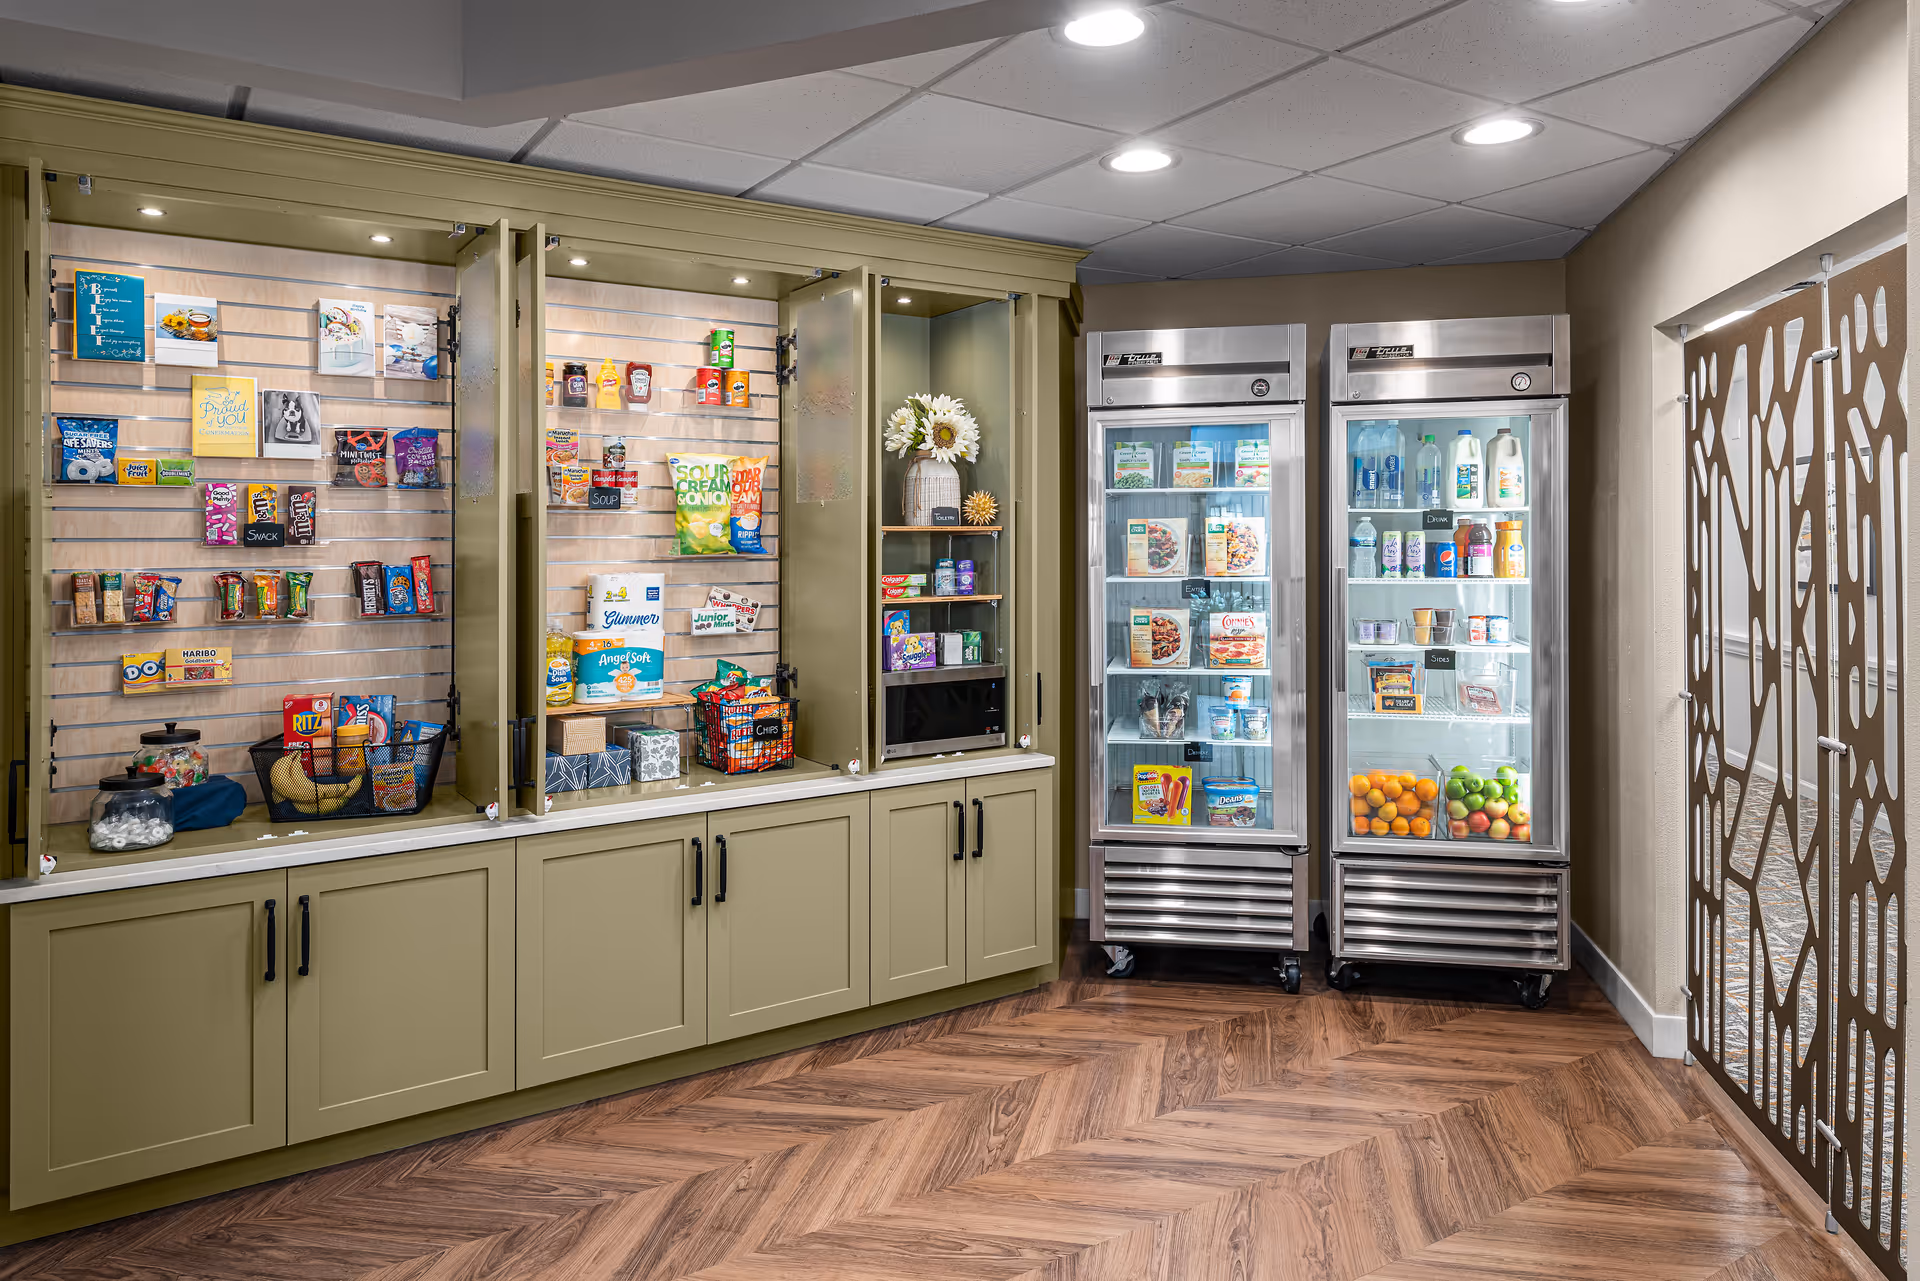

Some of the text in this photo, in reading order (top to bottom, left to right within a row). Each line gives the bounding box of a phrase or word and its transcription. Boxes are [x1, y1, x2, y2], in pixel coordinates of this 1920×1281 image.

[222, 396, 234, 406] So
[200, 400, 249, 419] Proud
[206, 418, 214, 428] of
[80, 438, 113, 448] SAVERS
[126, 463, 149, 471] Juicy
[676, 463, 730, 481] SOUR
[127, 470, 149, 478] Fruit
[676, 479, 730, 493] CREAM
[592, 492, 619, 505] SOUP
[1427, 514, 1448, 523] DRINK
[247, 529, 279, 541] SNACK
[362, 578, 377, 614] HERSHEY'S
[606, 586, 627, 599] 2 4
[602, 611, 660, 629] Glimmer
[694, 612, 729, 623] Junior
[1222, 614, 1254, 630] CONNIE'S
[713, 620, 735, 628] Mints
[603, 640, 612, 648] 16
[182, 649, 217, 658] HARIBO
[599, 651, 651, 667] Angel Soft
[902, 652, 927, 664] Snuggle
[1431, 654, 1450, 663] SIDES
[124, 658, 165, 681] DO
[618, 675, 633, 684] 425
[292, 713, 322, 732] RITZ
[756, 724, 779, 735] CHIPS
[1219, 794, 1244, 805] Dean's
